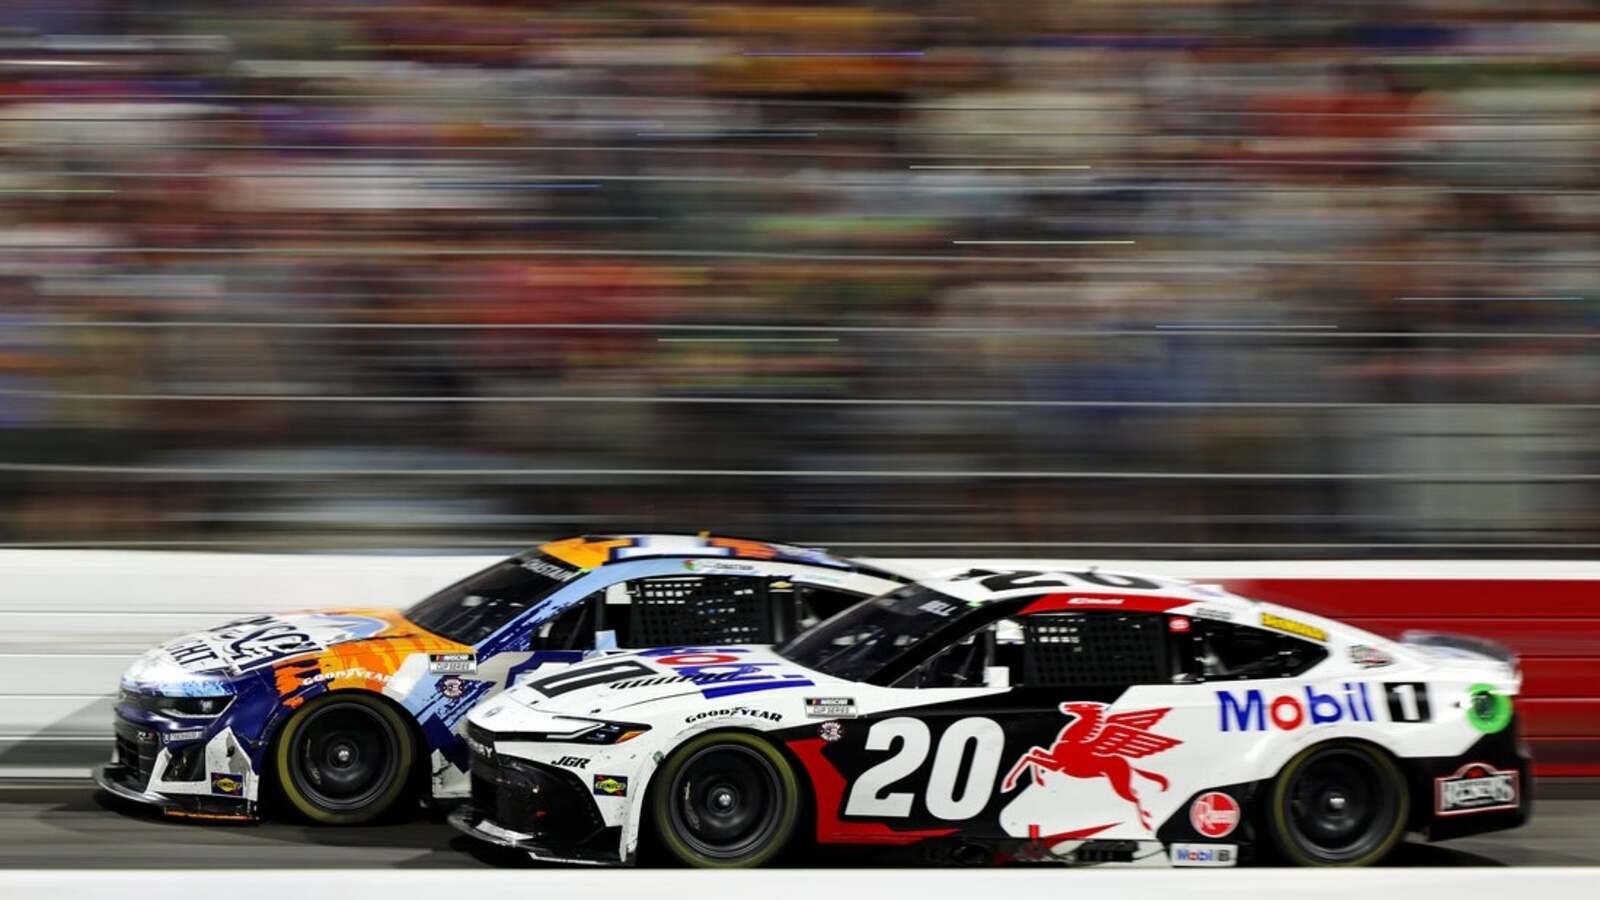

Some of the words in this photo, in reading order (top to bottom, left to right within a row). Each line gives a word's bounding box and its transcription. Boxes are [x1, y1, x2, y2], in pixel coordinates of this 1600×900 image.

[685, 706, 784, 724] GOODYEAR
[1216, 682, 1376, 732] Mobil
[1389, 683, 1427, 721] 1
[551, 756, 591, 769] JGR
[845, 716, 1005, 821] 20
